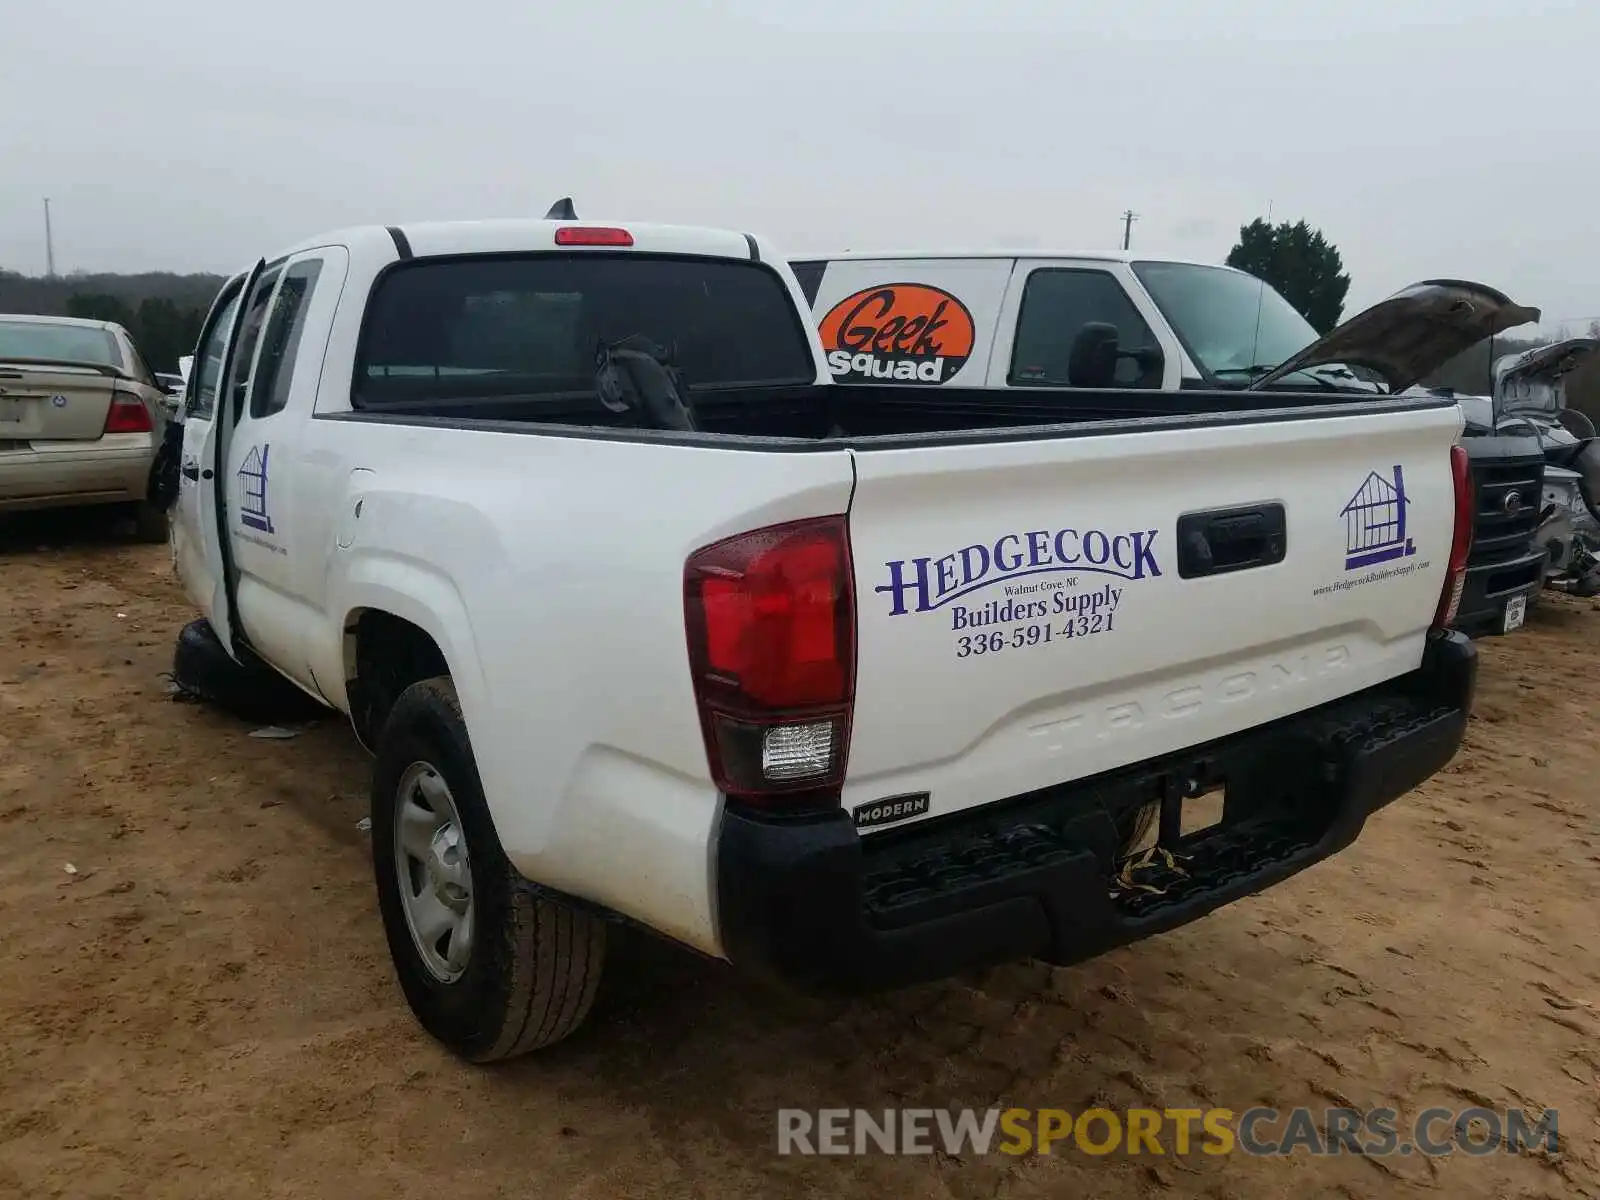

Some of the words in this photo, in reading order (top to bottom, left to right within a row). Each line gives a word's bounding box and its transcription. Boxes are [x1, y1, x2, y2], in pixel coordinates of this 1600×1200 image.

[837, 289, 949, 355] Geek
[875, 529, 1162, 616] HEDGECOCK
[1004, 584, 1038, 597] Walnut
[1066, 576, 1079, 588] NC
[952, 598, 1047, 630] Builders
[1053, 583, 1122, 616] Supply
[957, 612, 1114, 658] 336-591-4321
[1028, 645, 1350, 749] TACOMA
[859, 799, 925, 823] MODERN
